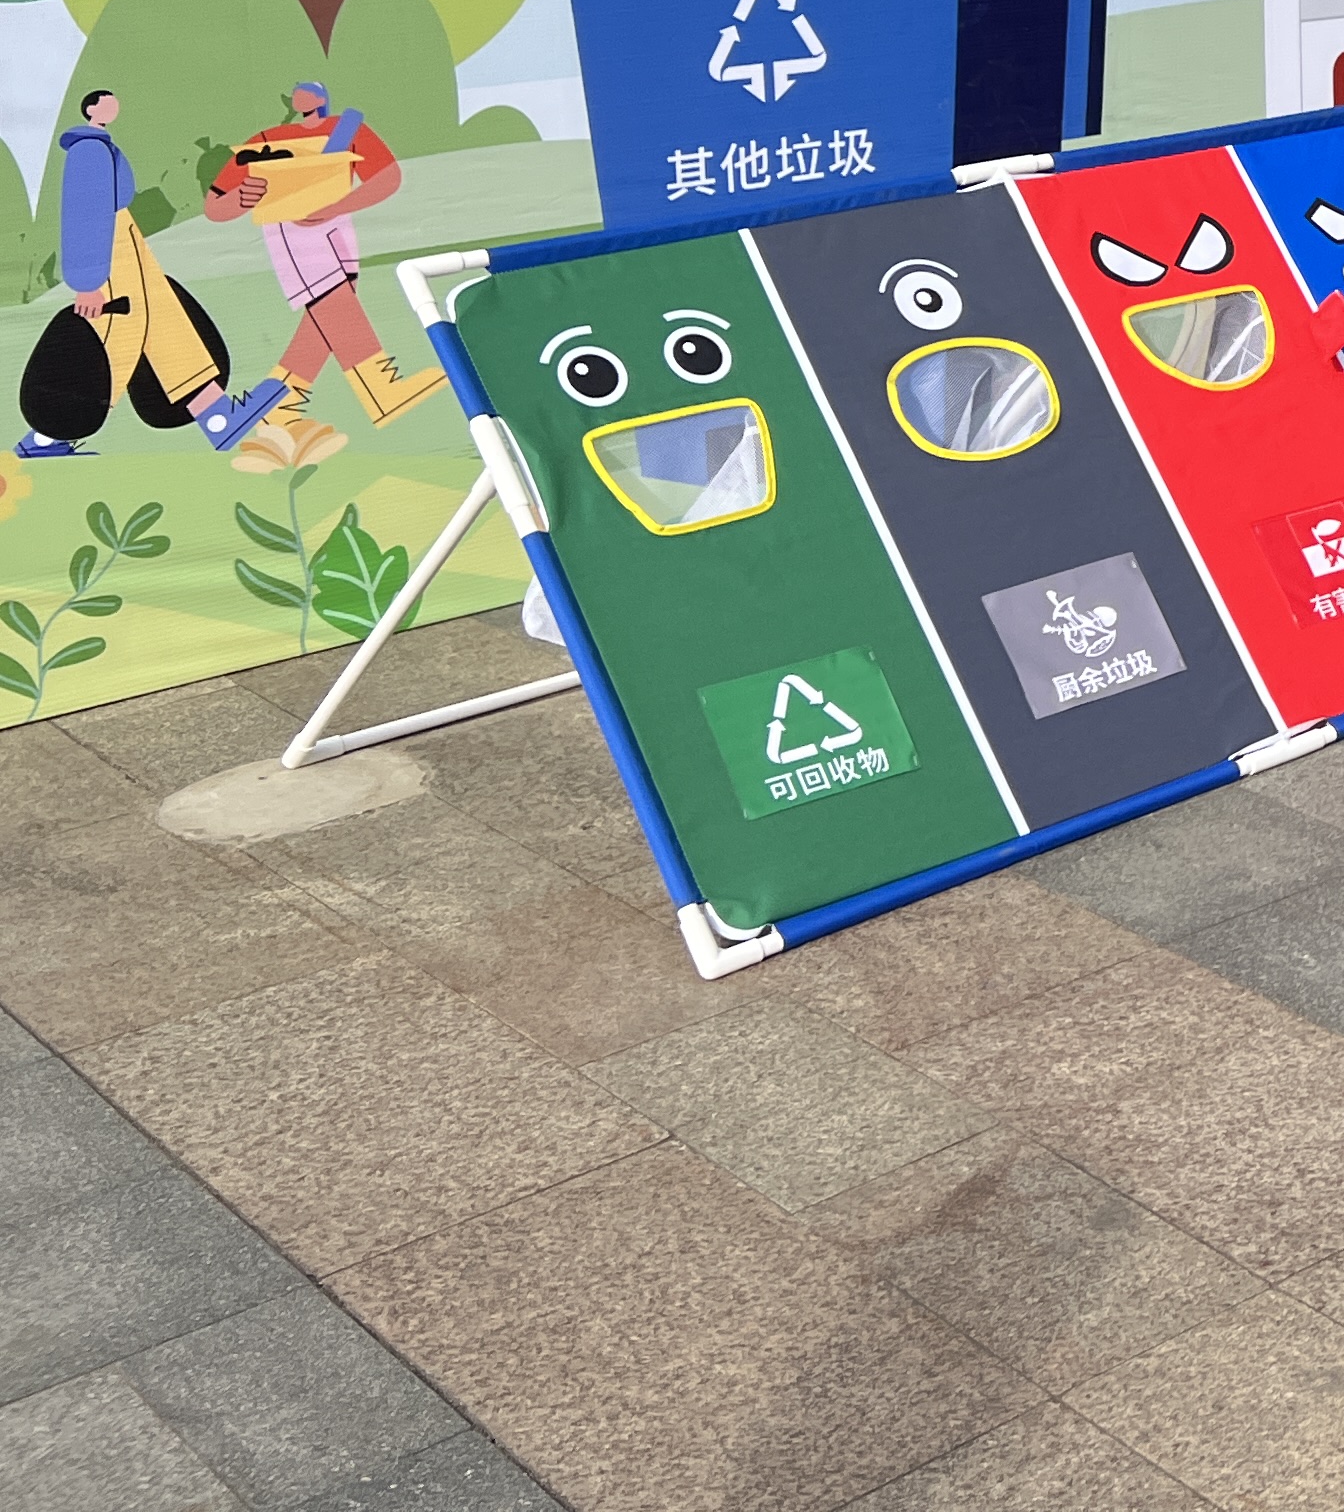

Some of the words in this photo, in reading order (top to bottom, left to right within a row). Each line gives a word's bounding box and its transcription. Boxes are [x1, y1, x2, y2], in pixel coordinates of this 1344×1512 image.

[666, 127, 877, 202] 其他垃圾
[1051, 649, 1159, 704] 厨余垃圾
[764, 746, 891, 804] 可回收物
